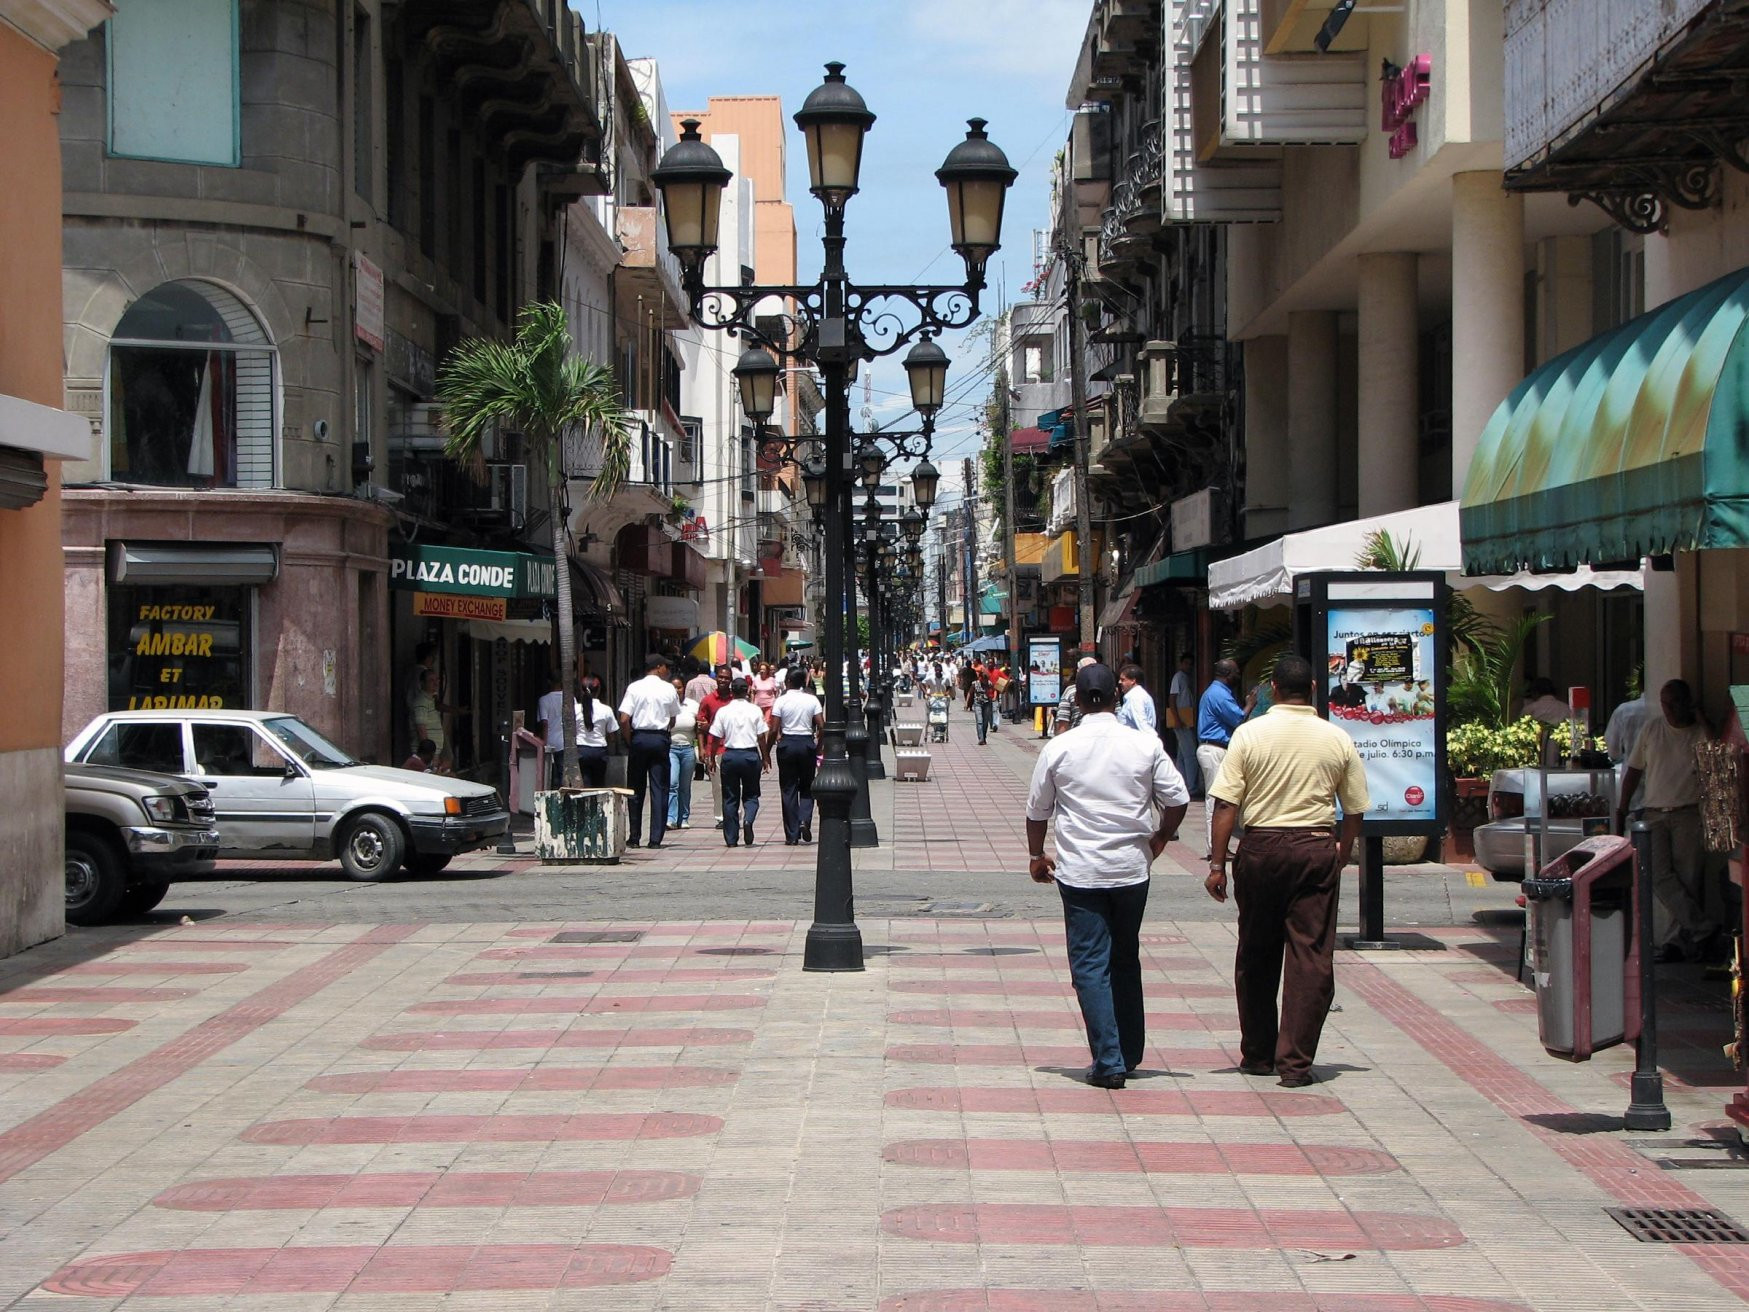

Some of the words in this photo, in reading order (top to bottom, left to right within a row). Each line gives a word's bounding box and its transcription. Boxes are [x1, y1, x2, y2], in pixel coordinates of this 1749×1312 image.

[391, 558, 455, 583] PLAZA
[457, 563, 514, 589] CONDE
[527, 560, 540, 593] PLAZA
[541, 563, 555, 595] CONDE
[139, 605, 216, 620] FACTORY
[424, 597, 456, 611] MONEY
[458, 599, 504, 617] EXCHANGE
[136, 633, 214, 657] AMBAR
[160, 668, 183, 683] ET
[1353, 740, 1378, 748] tadio
[1392, 750, 1413, 758] 6:30
